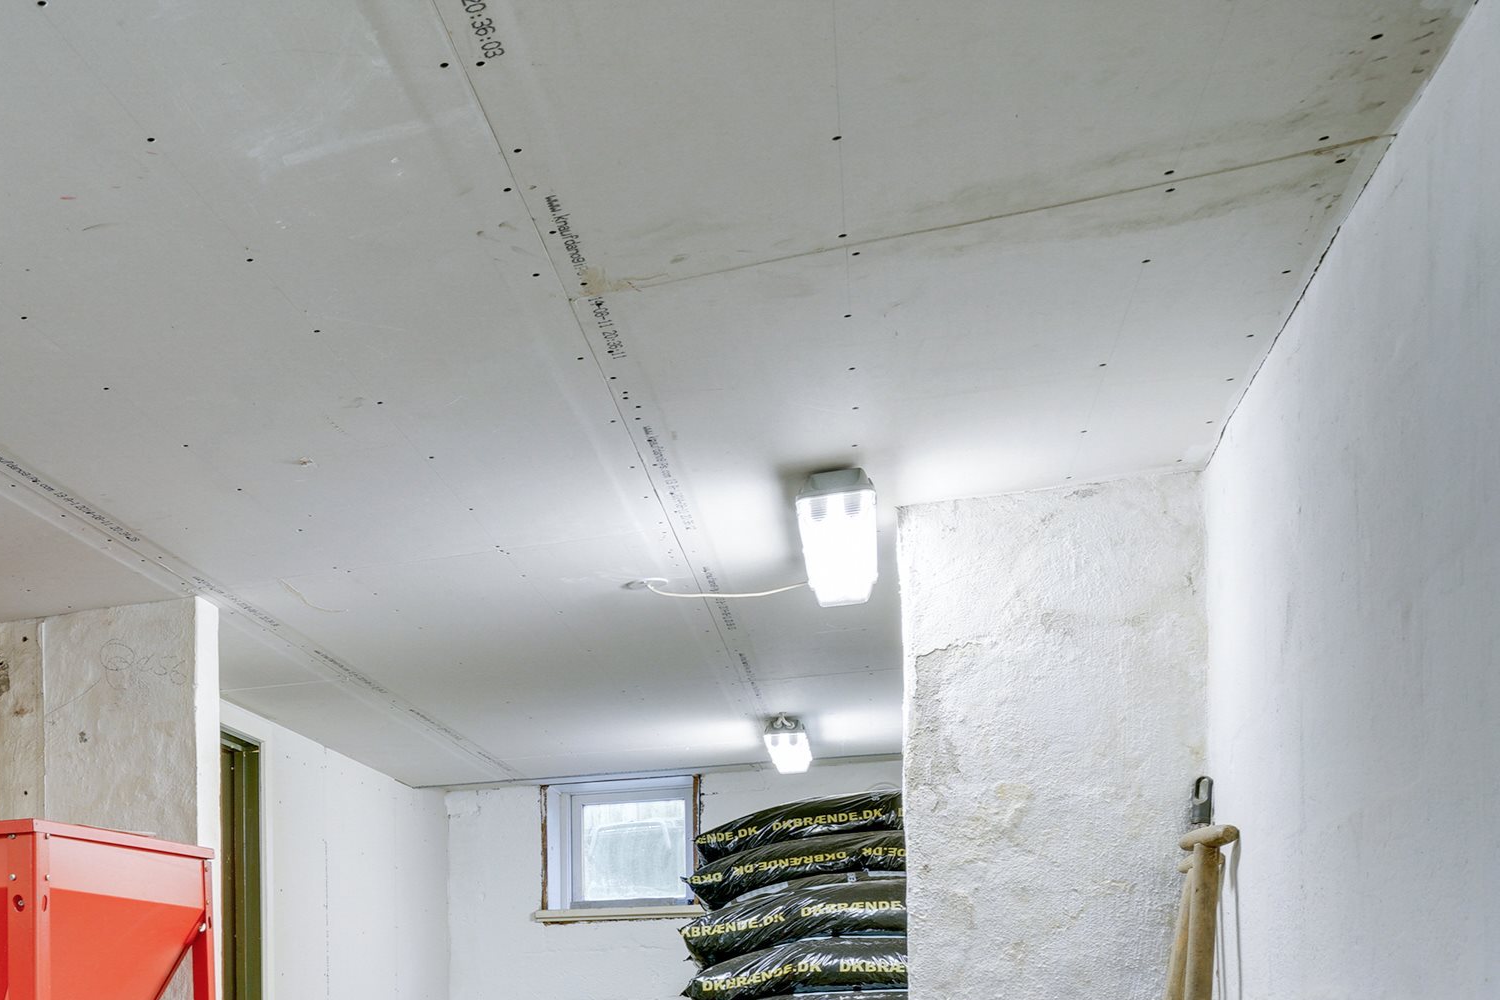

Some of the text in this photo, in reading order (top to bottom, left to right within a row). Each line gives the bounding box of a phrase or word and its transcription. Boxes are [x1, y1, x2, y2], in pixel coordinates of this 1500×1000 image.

[695, 825, 758, 845] ÆNDE.DK
[772, 808, 883, 831] DKBRÆNDE.DK
[733, 850, 847, 877] DKBRÆNDE.DK
[679, 899, 906, 938] KBRÆNDE.DK DKBRÆNDE.
[702, 961, 822, 992] DKBRÆNDE.DK
